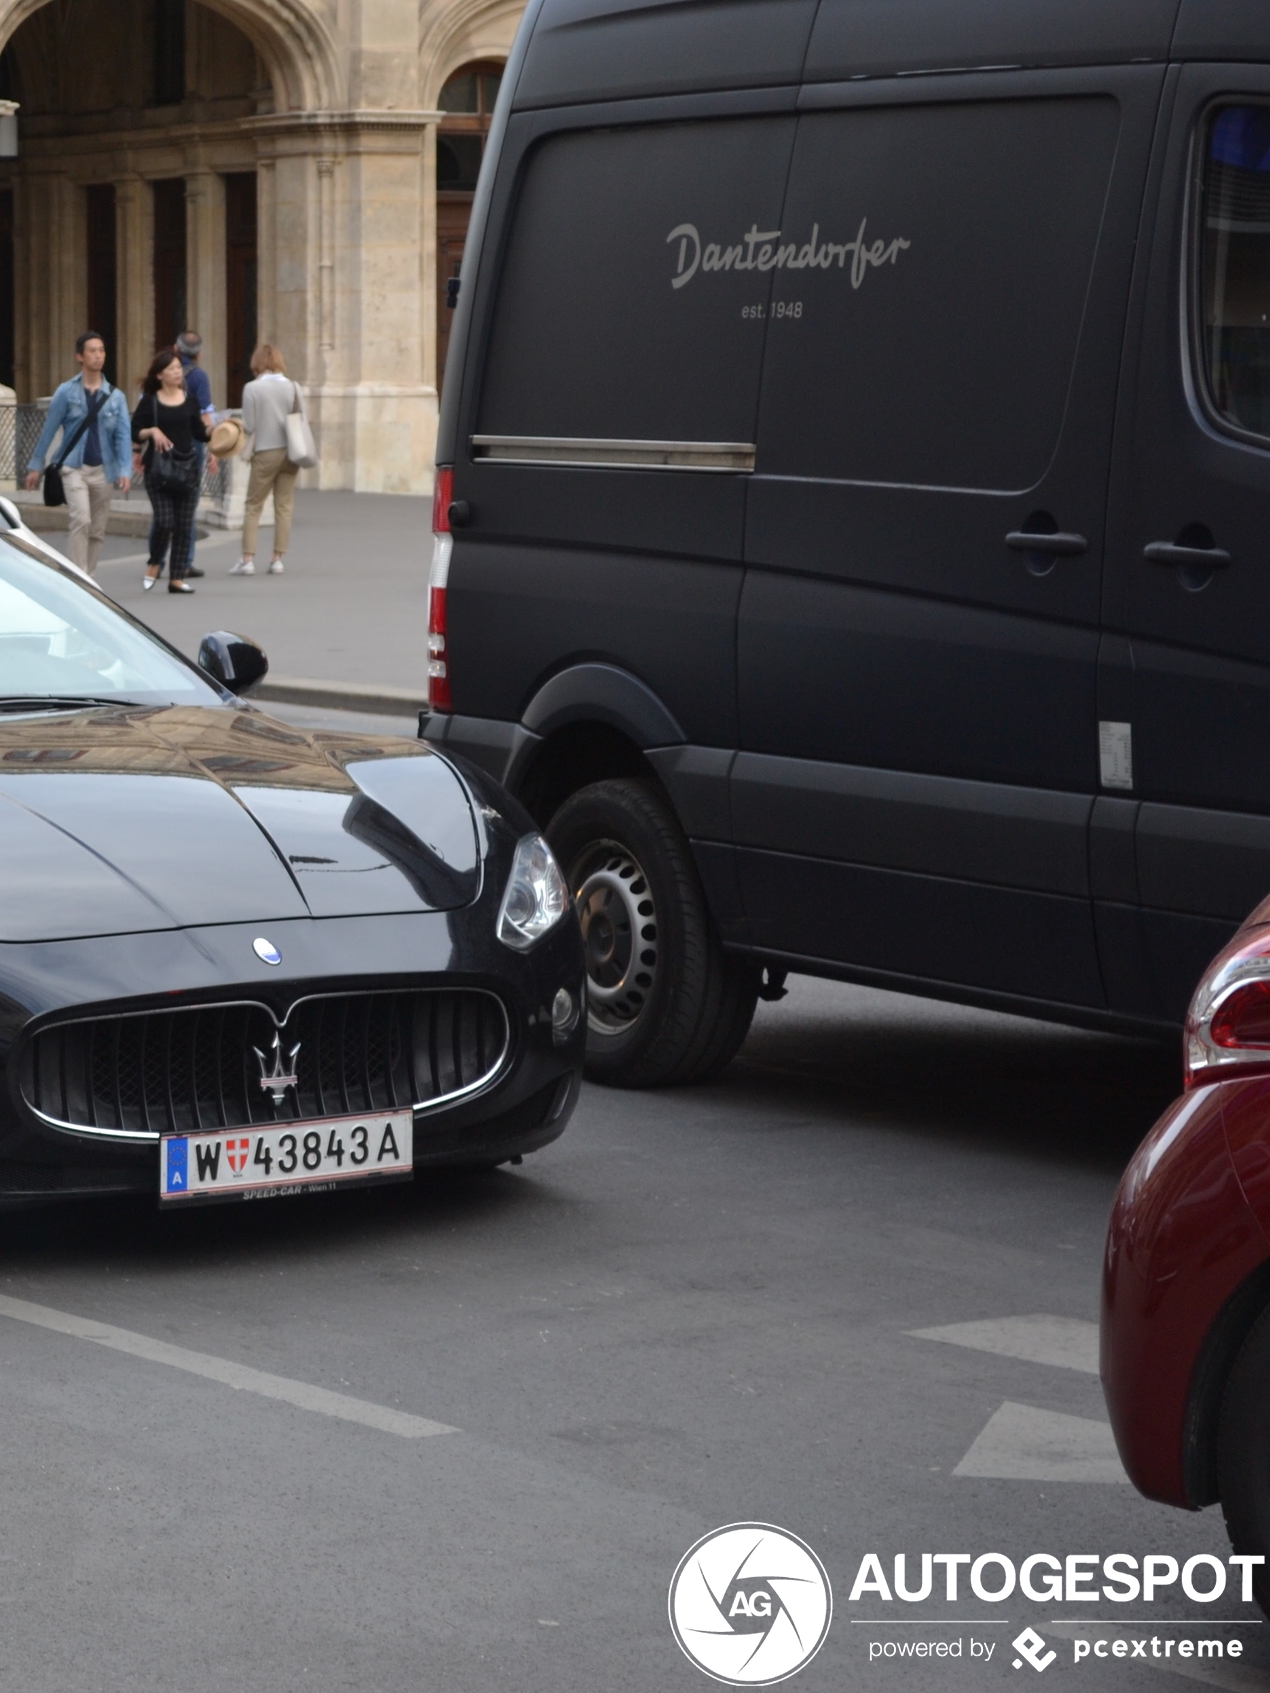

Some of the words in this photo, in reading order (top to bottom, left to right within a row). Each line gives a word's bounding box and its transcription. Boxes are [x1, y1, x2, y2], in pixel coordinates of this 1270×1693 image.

[666, 217, 911, 290] Dantendorfer
[742, 304, 766, 319] est.
[771, 302, 803, 319] 1948
[195, 1141, 222, 1182] W
[254, 1122, 400, 1175] 43843A
[172, 1171, 183, 1185] A
[243, 1186, 302, 1200] SPEED-CAR
[308, 1184, 328, 1192] Wien
